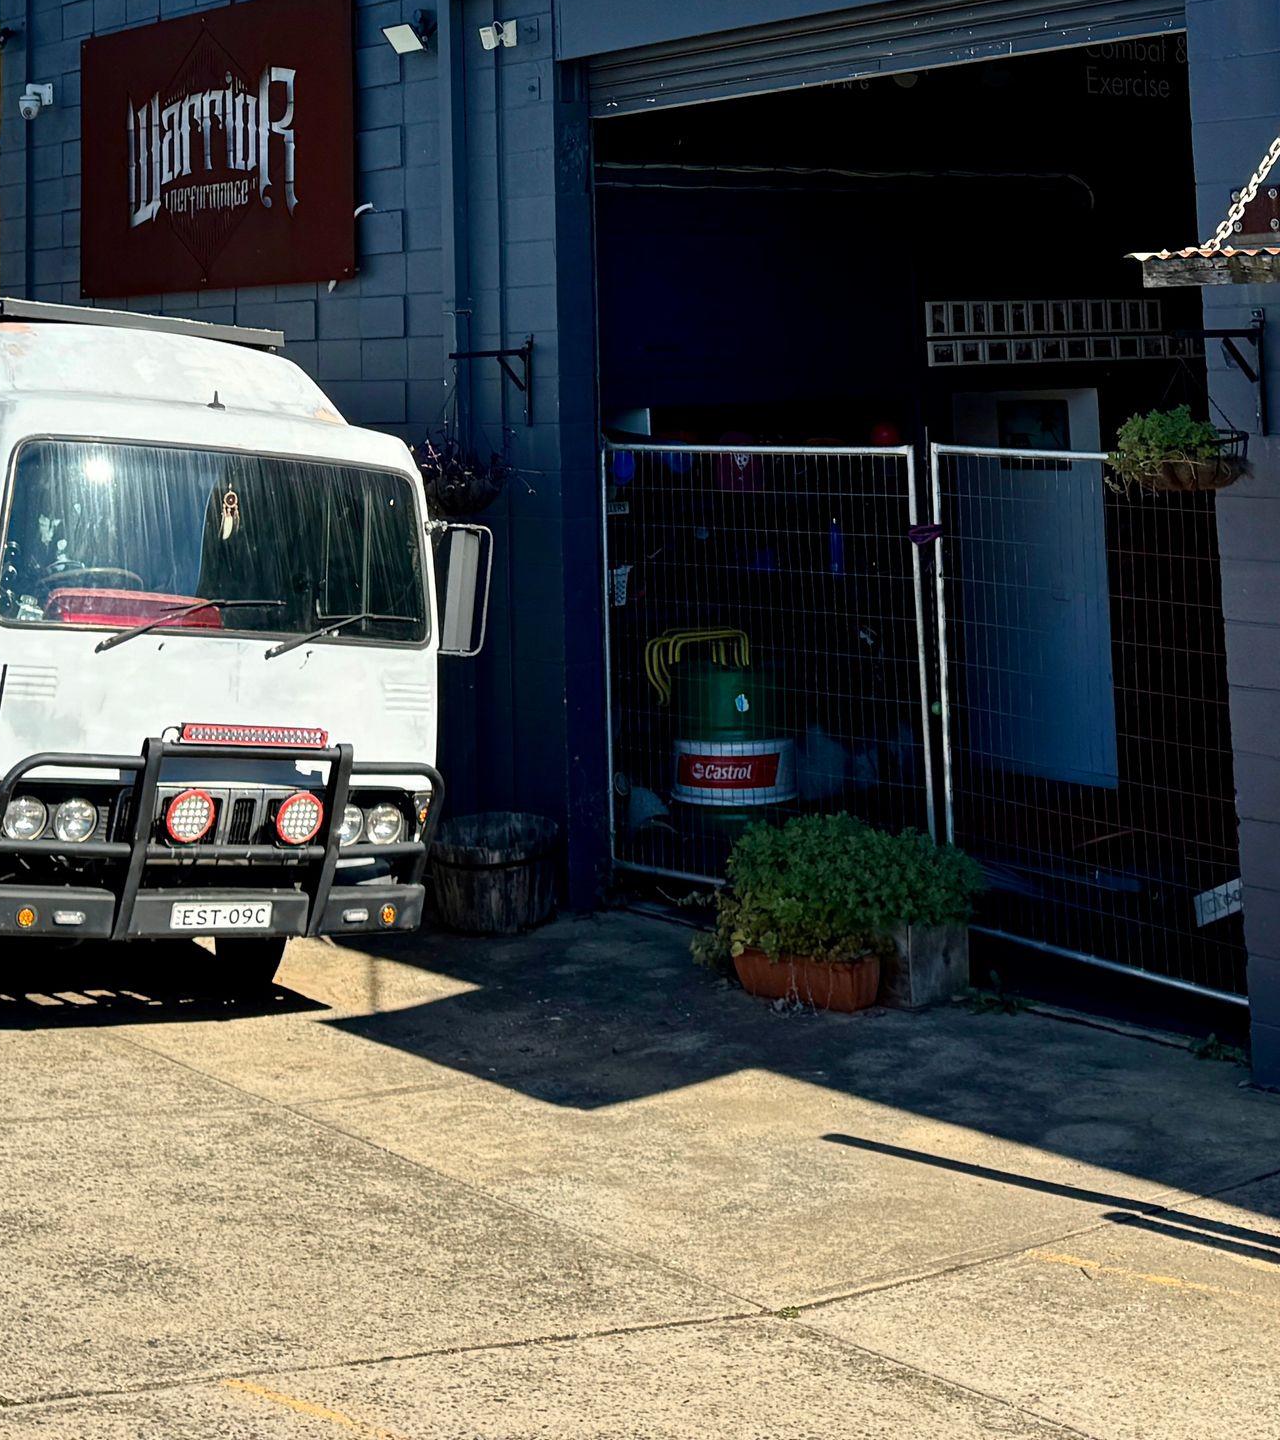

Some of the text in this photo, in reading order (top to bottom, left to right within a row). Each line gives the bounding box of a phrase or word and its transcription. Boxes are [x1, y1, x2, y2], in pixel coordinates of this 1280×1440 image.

[1175, 36, 1186, 64] &
[1086, 65, 1170, 98] Exercise
[705, 763, 753, 780] Castrol
